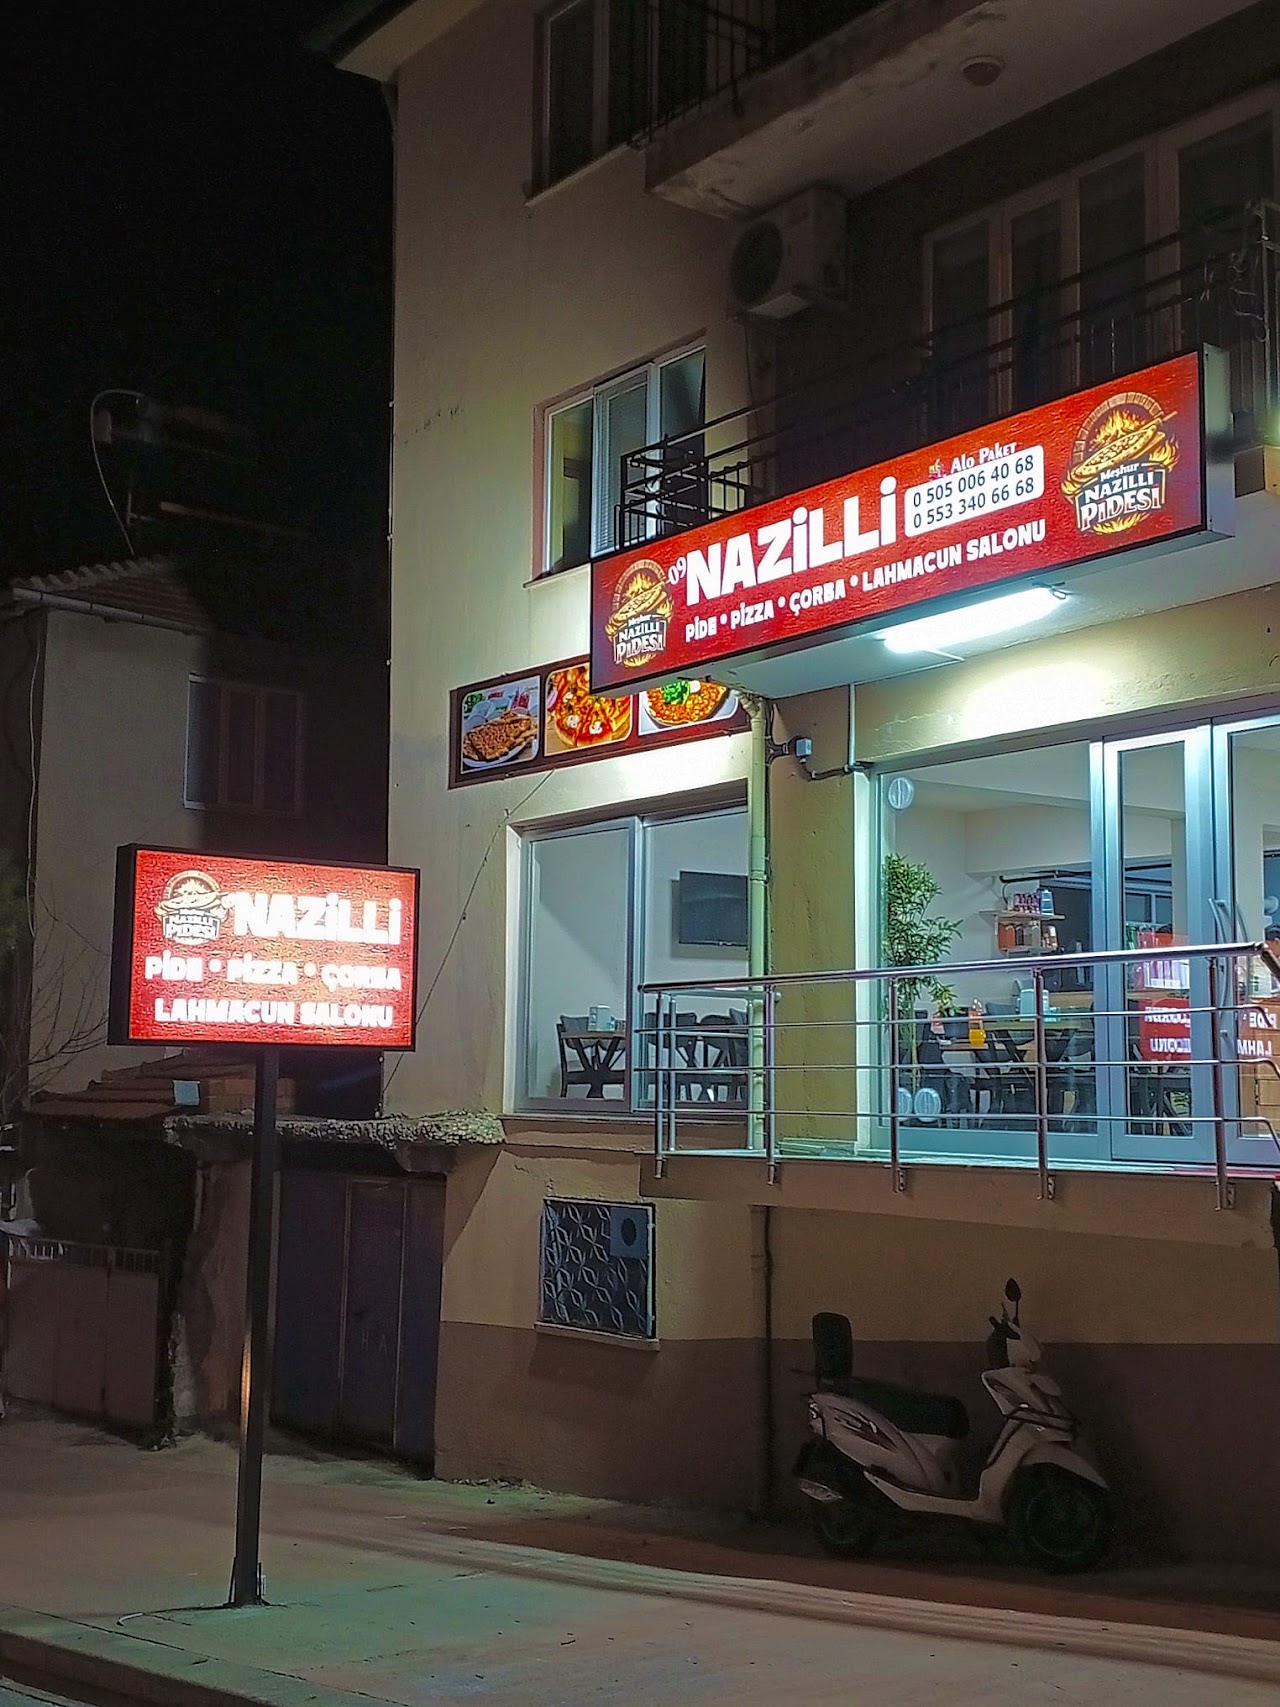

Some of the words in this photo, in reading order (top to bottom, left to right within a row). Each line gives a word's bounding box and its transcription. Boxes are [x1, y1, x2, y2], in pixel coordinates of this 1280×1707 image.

[913, 492, 921, 507] 0
[926, 481, 953, 503] 505
[958, 470, 985, 493] 006
[991, 463, 1009, 481] 40
[1015, 455, 1034, 474] 68
[951, 453, 975, 474] Alo
[913, 513, 922, 528] 0
[927, 503, 953, 525] 553
[958, 492, 986, 515] 340
[991, 484, 1010, 504] 66
[1015, 477, 1034, 496] 68
[789, 578, 846, 615] ÇORBA
[862, 543, 962, 592] LAHMACUN
[966, 518, 1046, 562] SALONU
[154, 998, 295, 1025] LAHMACUN
[299, 1002, 393, 1028] SALONU
